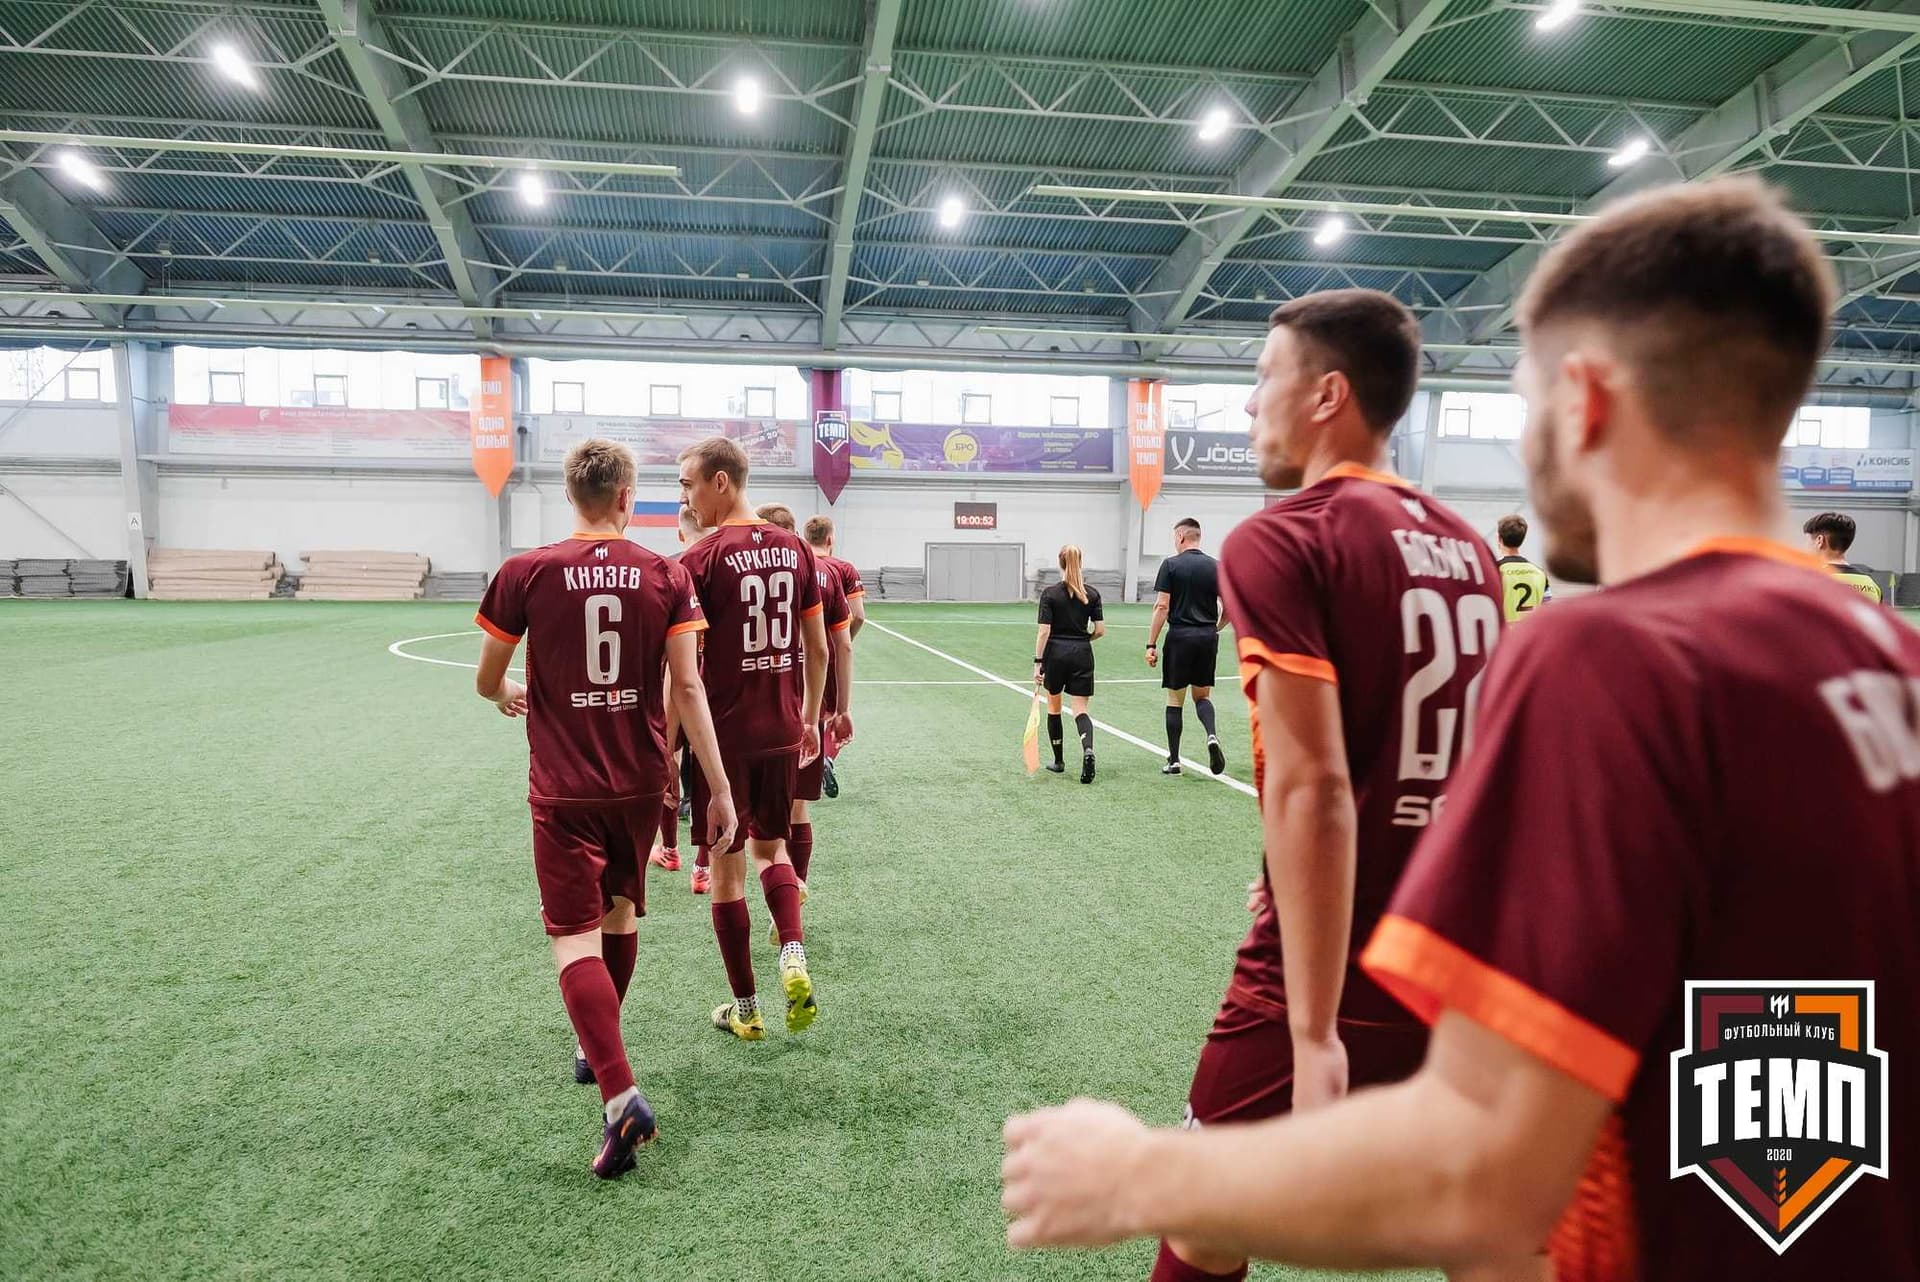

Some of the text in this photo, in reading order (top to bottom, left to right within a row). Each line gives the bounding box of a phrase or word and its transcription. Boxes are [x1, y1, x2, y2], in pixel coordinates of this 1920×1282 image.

[724, 547, 798, 574] ЧЕРКАСОВ
[563, 565, 641, 591] КНЯЗЕВ
[1512, 582, 1534, 612] 2
[740, 571, 794, 653] 33
[584, 594, 623, 685] 6
[741, 653, 792, 672] SEUS
[570, 688, 639, 708] SEUS
